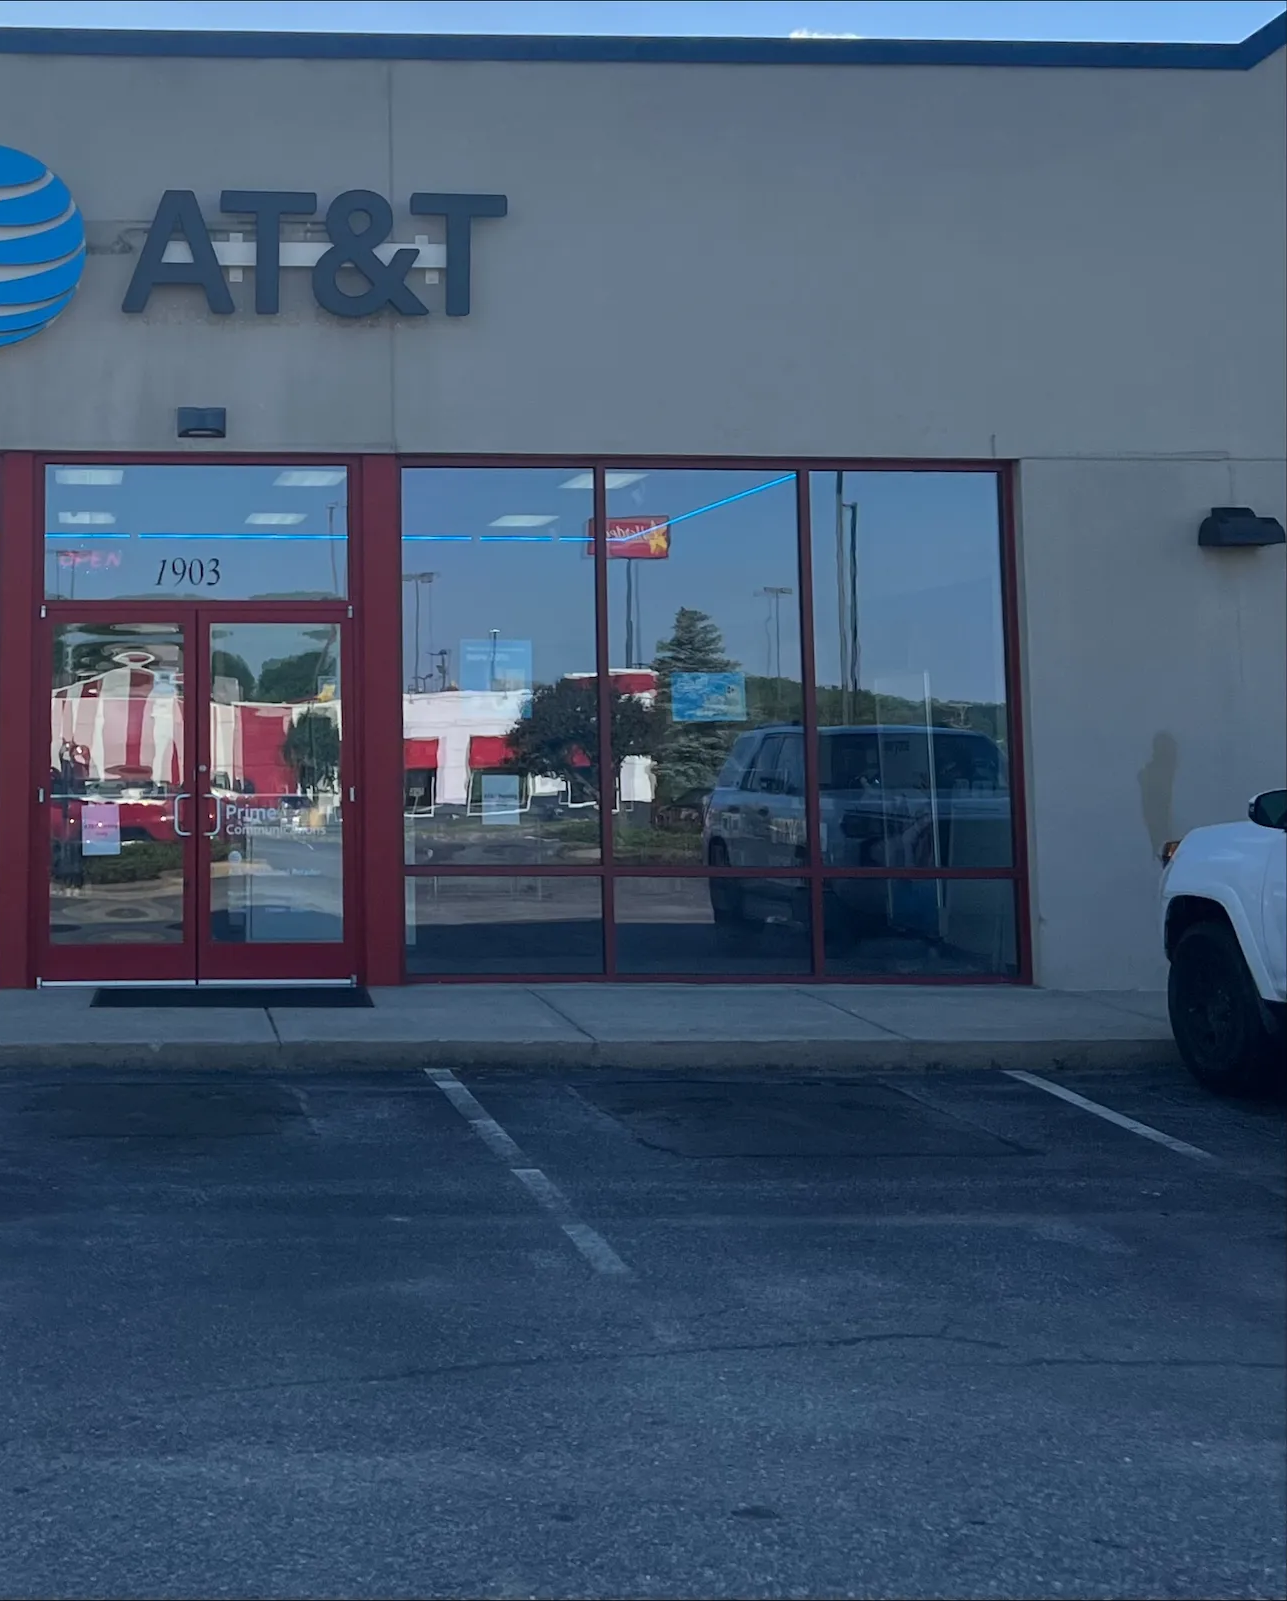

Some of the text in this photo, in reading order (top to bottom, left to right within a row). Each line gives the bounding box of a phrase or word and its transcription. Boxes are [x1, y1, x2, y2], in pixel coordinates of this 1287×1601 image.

[122, 189, 507, 317] AT&T
[59, 551, 122, 568] OPEN
[155, 557, 221, 586] 1903
[226, 804, 277, 820] Prime
